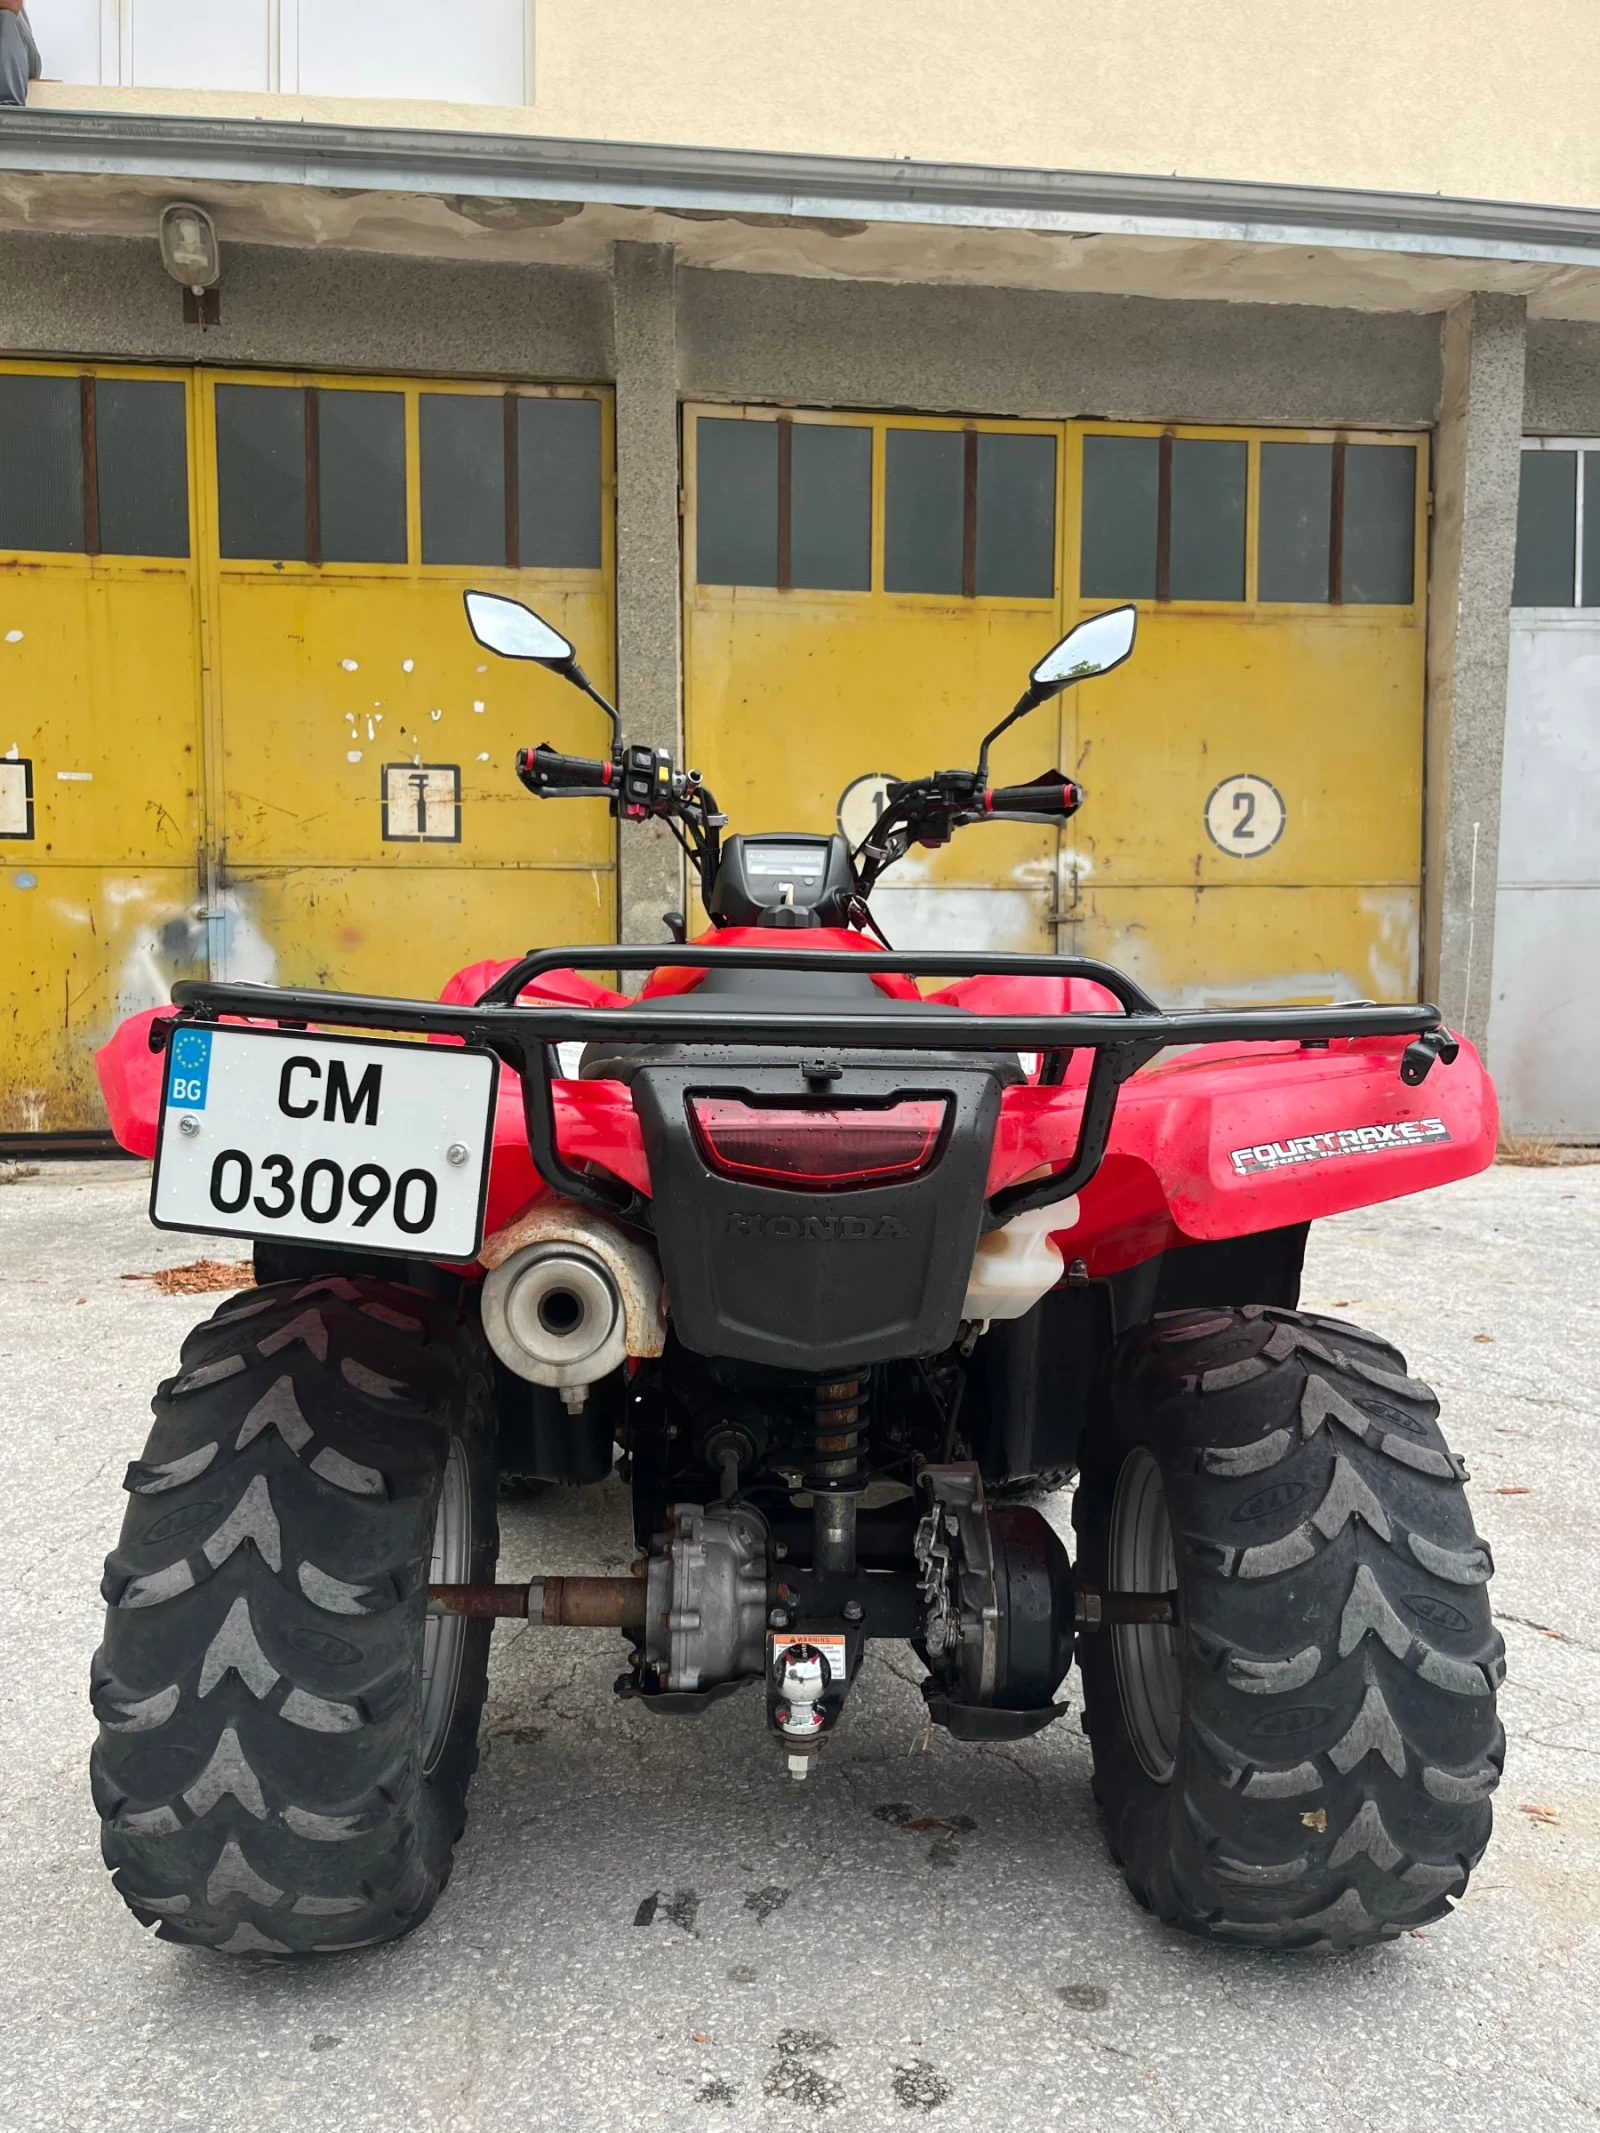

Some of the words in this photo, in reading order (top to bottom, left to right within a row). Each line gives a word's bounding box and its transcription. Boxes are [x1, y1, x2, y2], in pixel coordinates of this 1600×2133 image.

[1232, 792, 1254, 838] 2
[173, 1078, 201, 1101] BG
[278, 1056, 383, 1126] CM
[209, 1149, 438, 1234] 03090
[725, 1212, 911, 1240] HONDA
